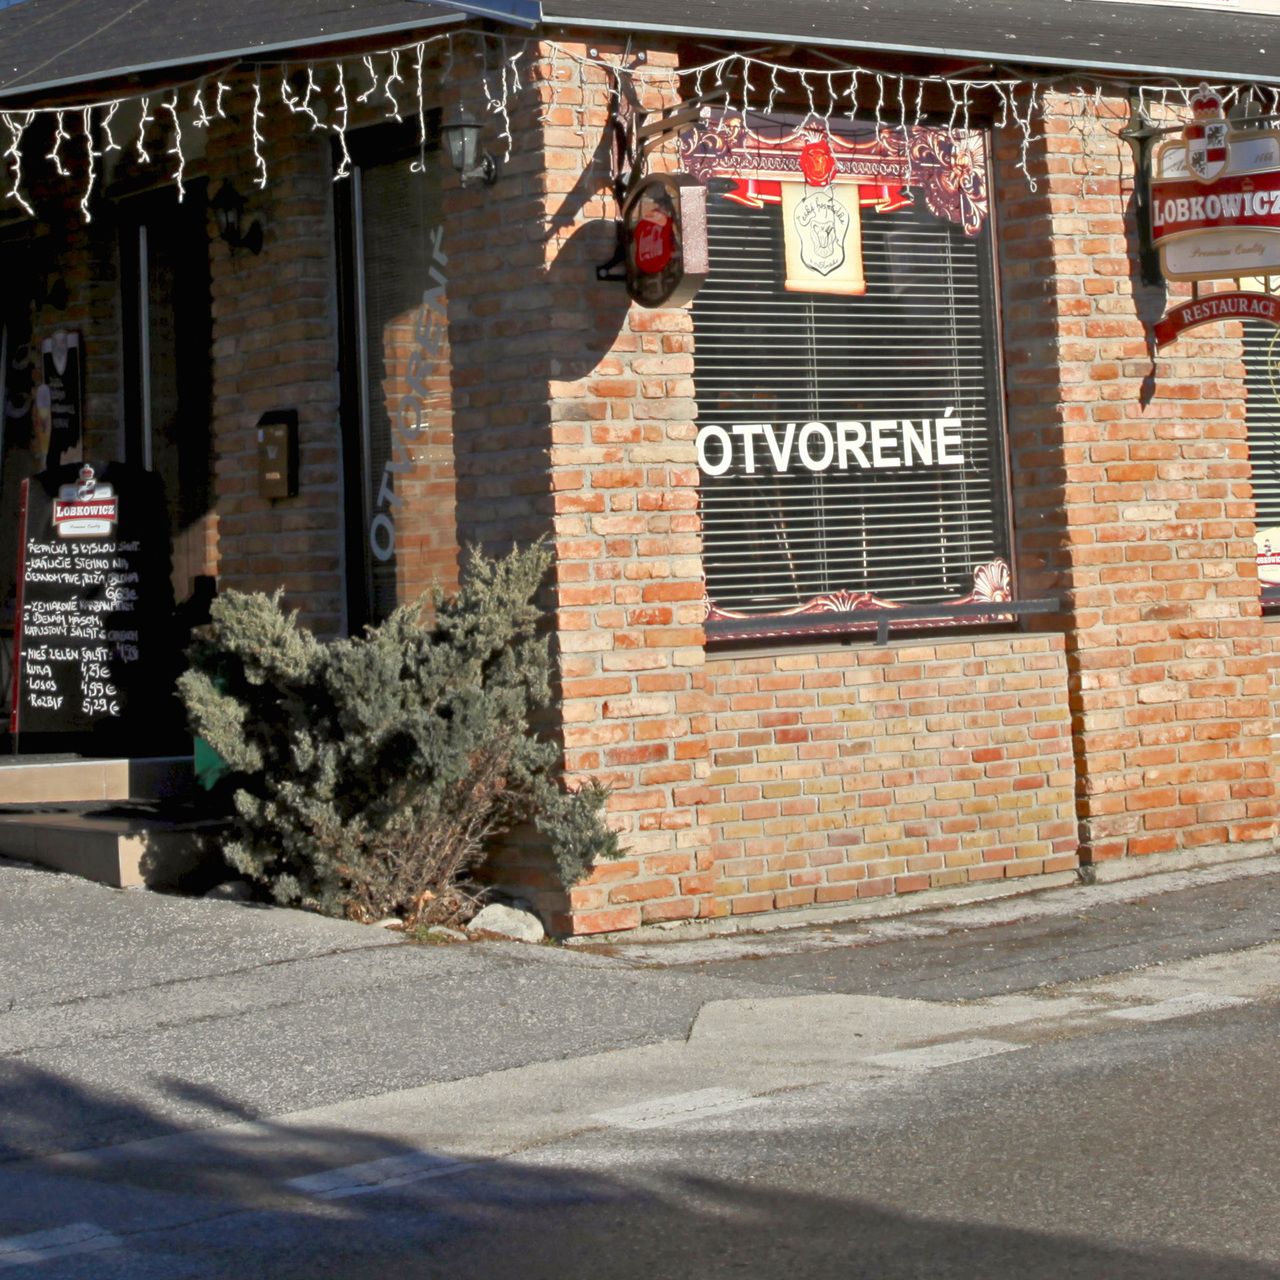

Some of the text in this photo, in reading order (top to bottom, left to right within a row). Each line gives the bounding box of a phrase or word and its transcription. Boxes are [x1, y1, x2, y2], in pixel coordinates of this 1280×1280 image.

[1190, 241, 1267, 258] Premium Quality
[1182, 297, 1276, 323] RESTAURACE
[695, 407, 964, 476] OTVORENÉ
[56, 505, 115, 517] LOBKOWICZ
